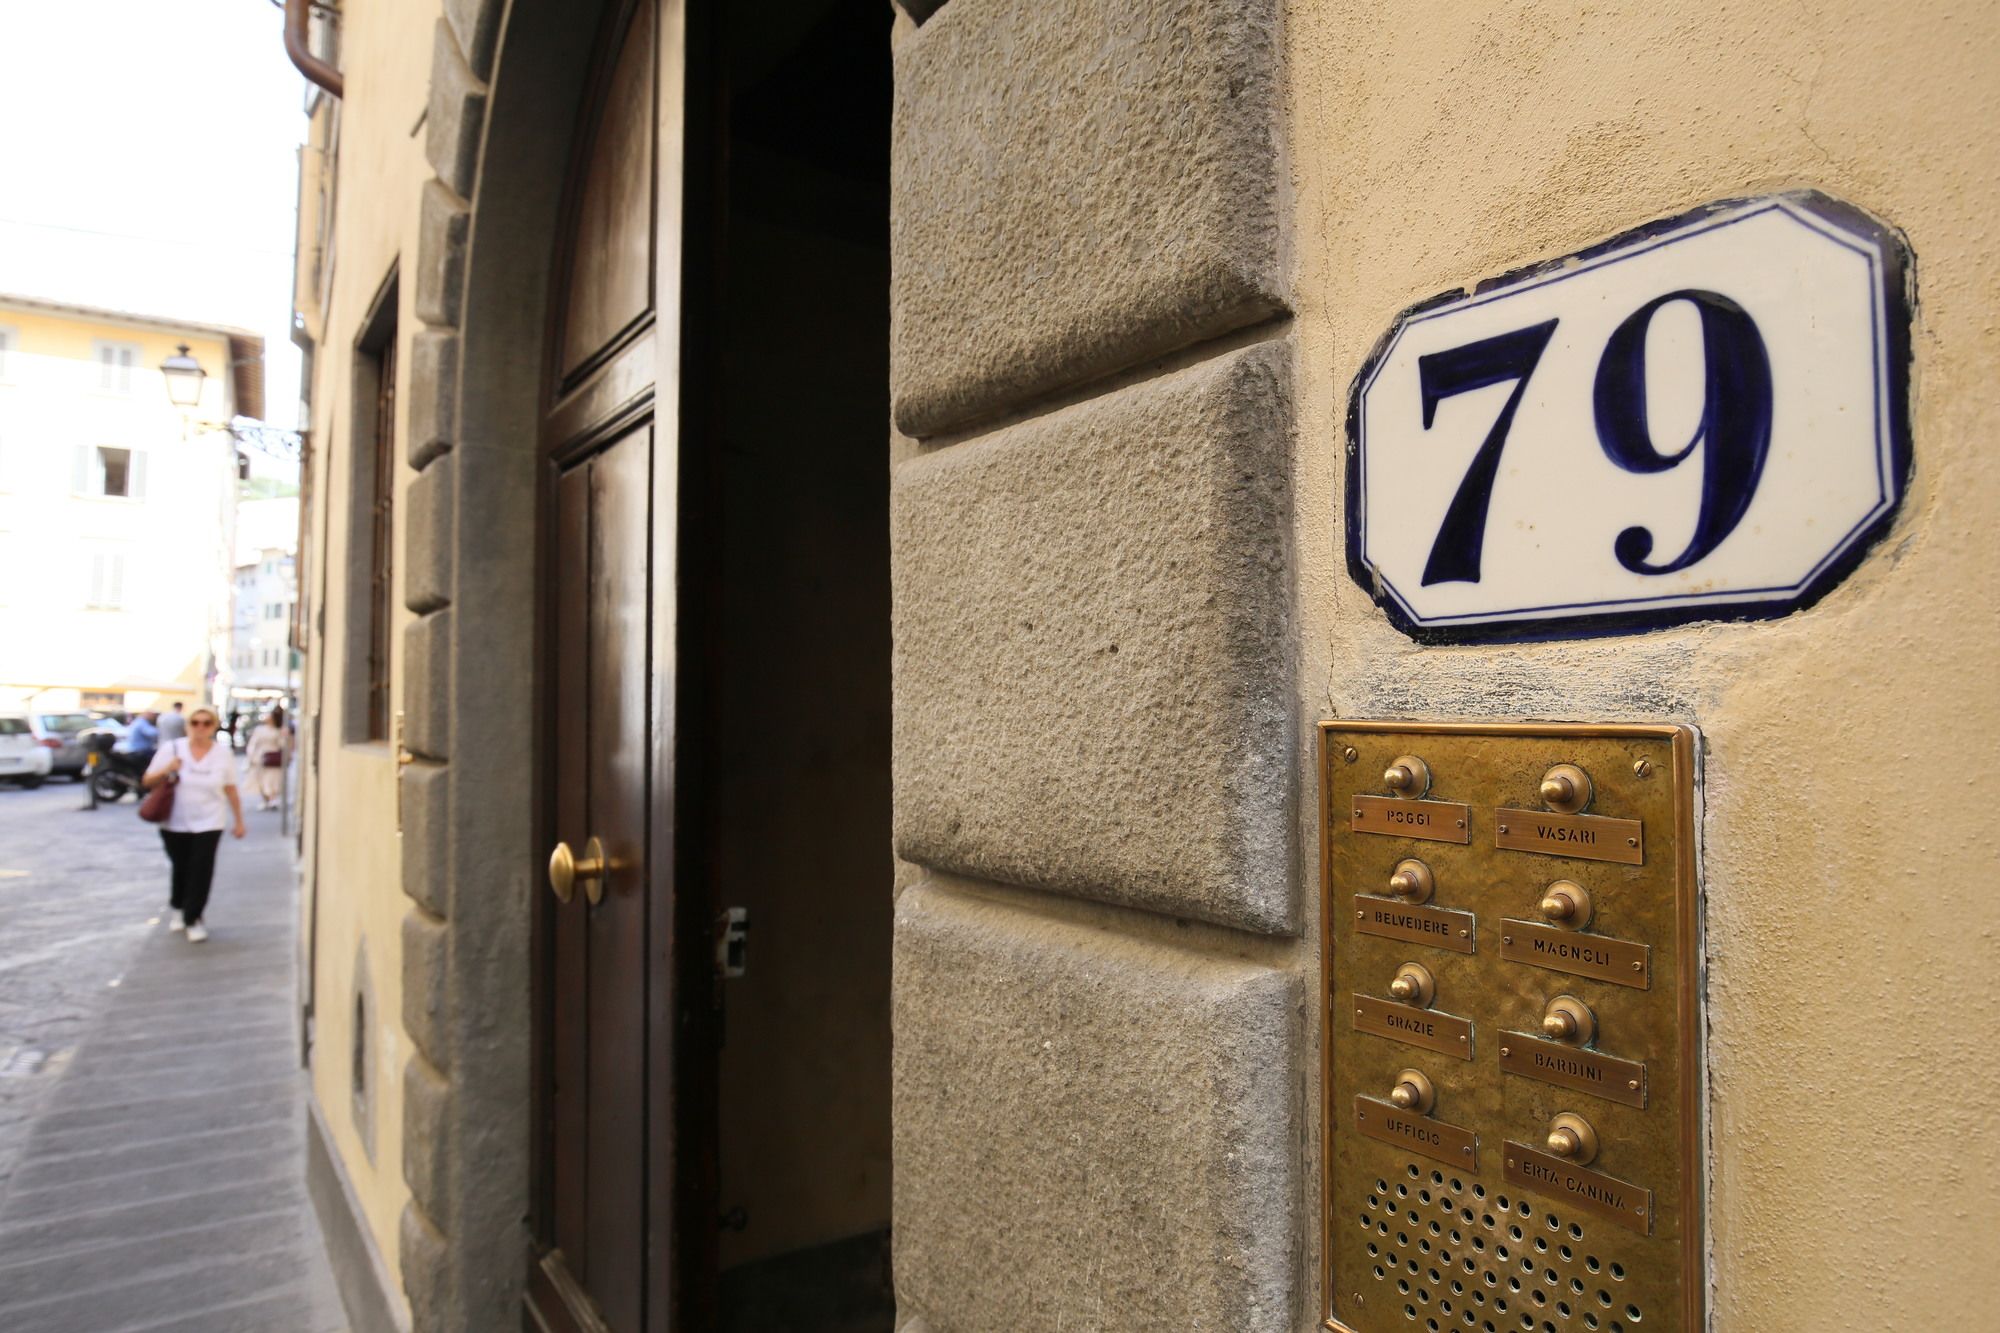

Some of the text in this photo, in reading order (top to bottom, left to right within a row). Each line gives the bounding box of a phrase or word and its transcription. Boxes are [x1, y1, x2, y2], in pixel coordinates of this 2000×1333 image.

[1418, 288, 1774, 586] 79
[1386, 809, 1431, 826] POGGI
[1537, 825, 1597, 845] VASARI
[1375, 910, 1449, 936] BELVEDERE
[1534, 938, 1610, 966] MAGNOLI
[1387, 1014, 1435, 1037] GRAZIE
[1535, 1052, 1603, 1082] BARDINI
[1386, 1118, 1440, 1146] UFFICIO
[1523, 1161, 1626, 1211] ERTA CANINA
